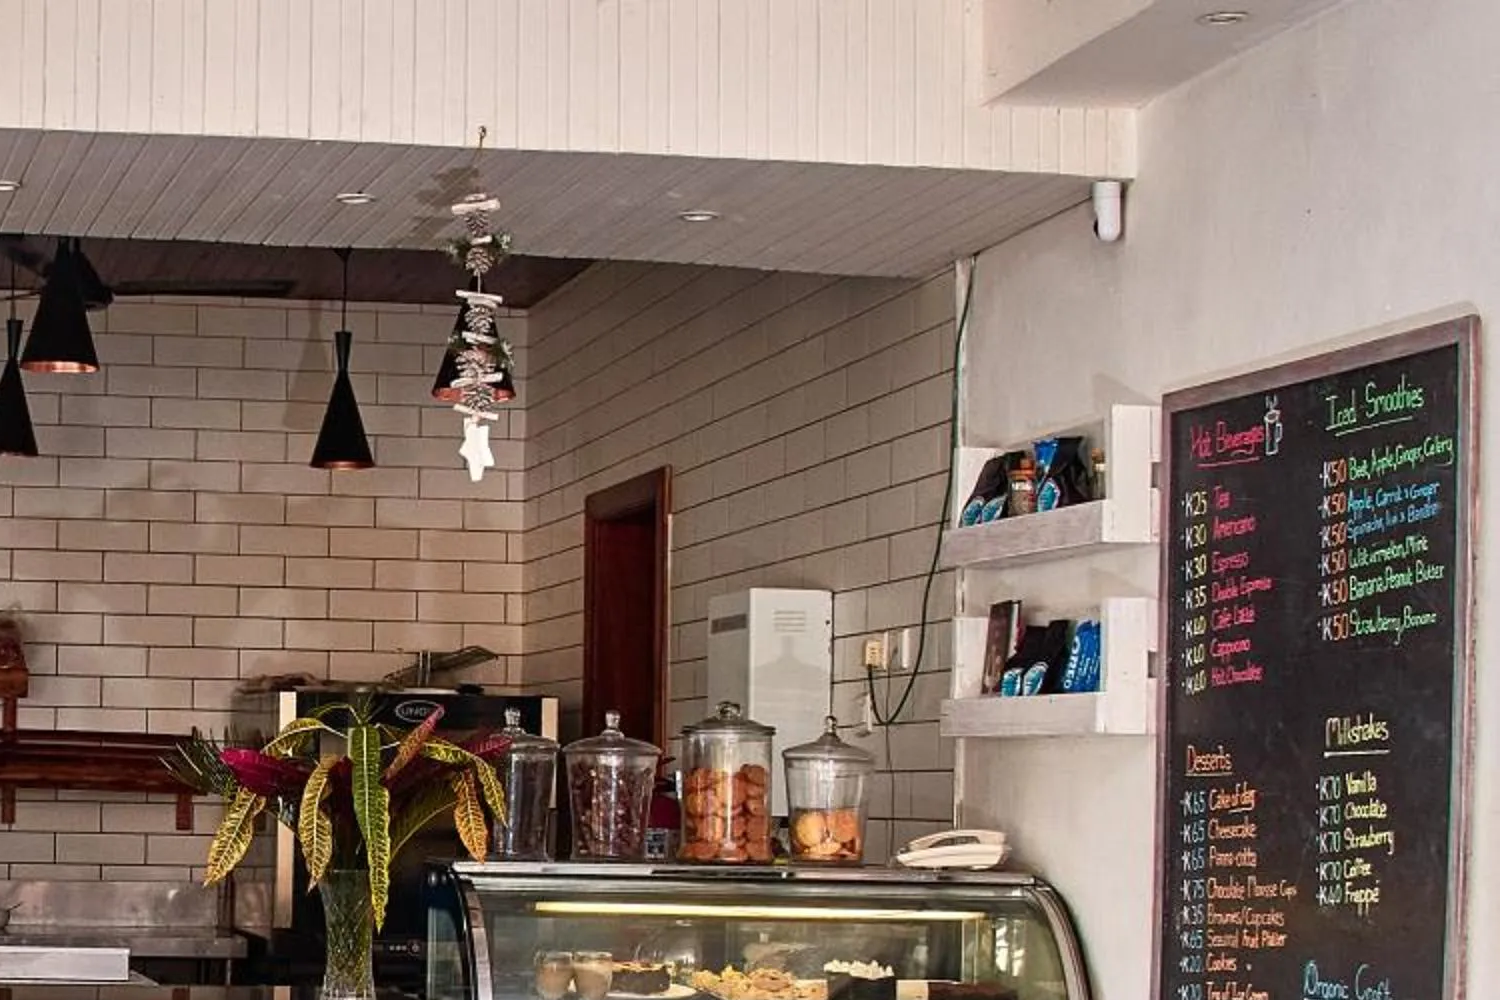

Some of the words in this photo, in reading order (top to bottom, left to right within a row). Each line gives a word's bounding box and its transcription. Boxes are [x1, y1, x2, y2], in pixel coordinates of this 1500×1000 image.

[1365, 374, 1424, 418] Smoothies
[1190, 420, 1212, 458] Hot
[1216, 420, 1264, 454] Beverages
[1323, 459, 1347, 489] K50
[1424, 436, 1454, 467] Celery
[1213, 485, 1230, 510] Tea
[1322, 492, 1347, 518] K50
[1185, 523, 1207, 551] K30
[1213, 516, 1257, 540] Americano
[1321, 521, 1347, 549] K50
[1185, 553, 1207, 581] K30
[1321, 549, 1347, 577] K50
[1185, 585, 1207, 610] K35
[1321, 578, 1348, 607] K50
[1415, 560, 1445, 583] Butter
[1321, 613, 1349, 641] K50
[1063, 635, 1081, 689] OREO
[1325, 711, 1390, 748] Milkshakes
[1187, 744, 1233, 773] Desserts
[1319, 775, 1341, 801] K70
[1345, 770, 1378, 796] Vanilla
[1319, 804, 1341, 829] K70
[1319, 830, 1341, 855] K70
[1344, 856, 1374, 880] Coffee
[1207, 875, 1245, 900] Chocolate
[1206, 952, 1238, 972] Cookies
[1303, 960, 1350, 1000] Organic
